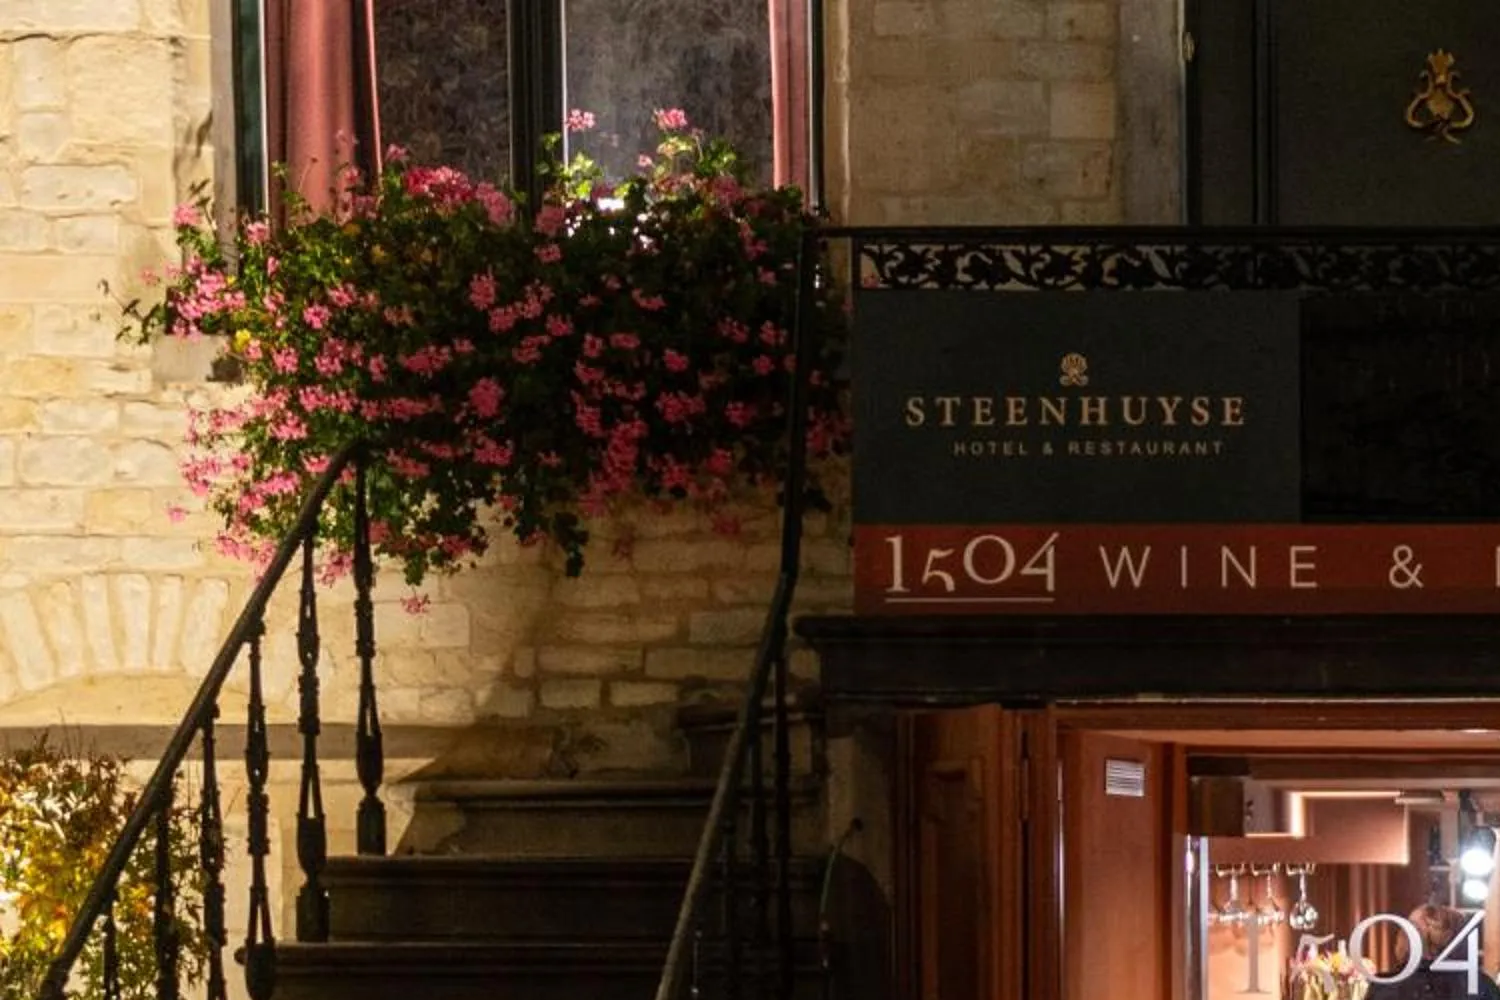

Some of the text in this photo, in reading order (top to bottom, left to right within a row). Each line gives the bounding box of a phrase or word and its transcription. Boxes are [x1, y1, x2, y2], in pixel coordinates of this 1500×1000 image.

[905, 396, 1246, 426] STEENHUYSE
[953, 441, 1225, 456] HOTEL & RESTAURANT
[884, 531, 1060, 594] 1504
[1099, 545, 1319, 589] WINE
[1388, 544, 1424, 589] &
[1235, 908, 1487, 995] 1504
